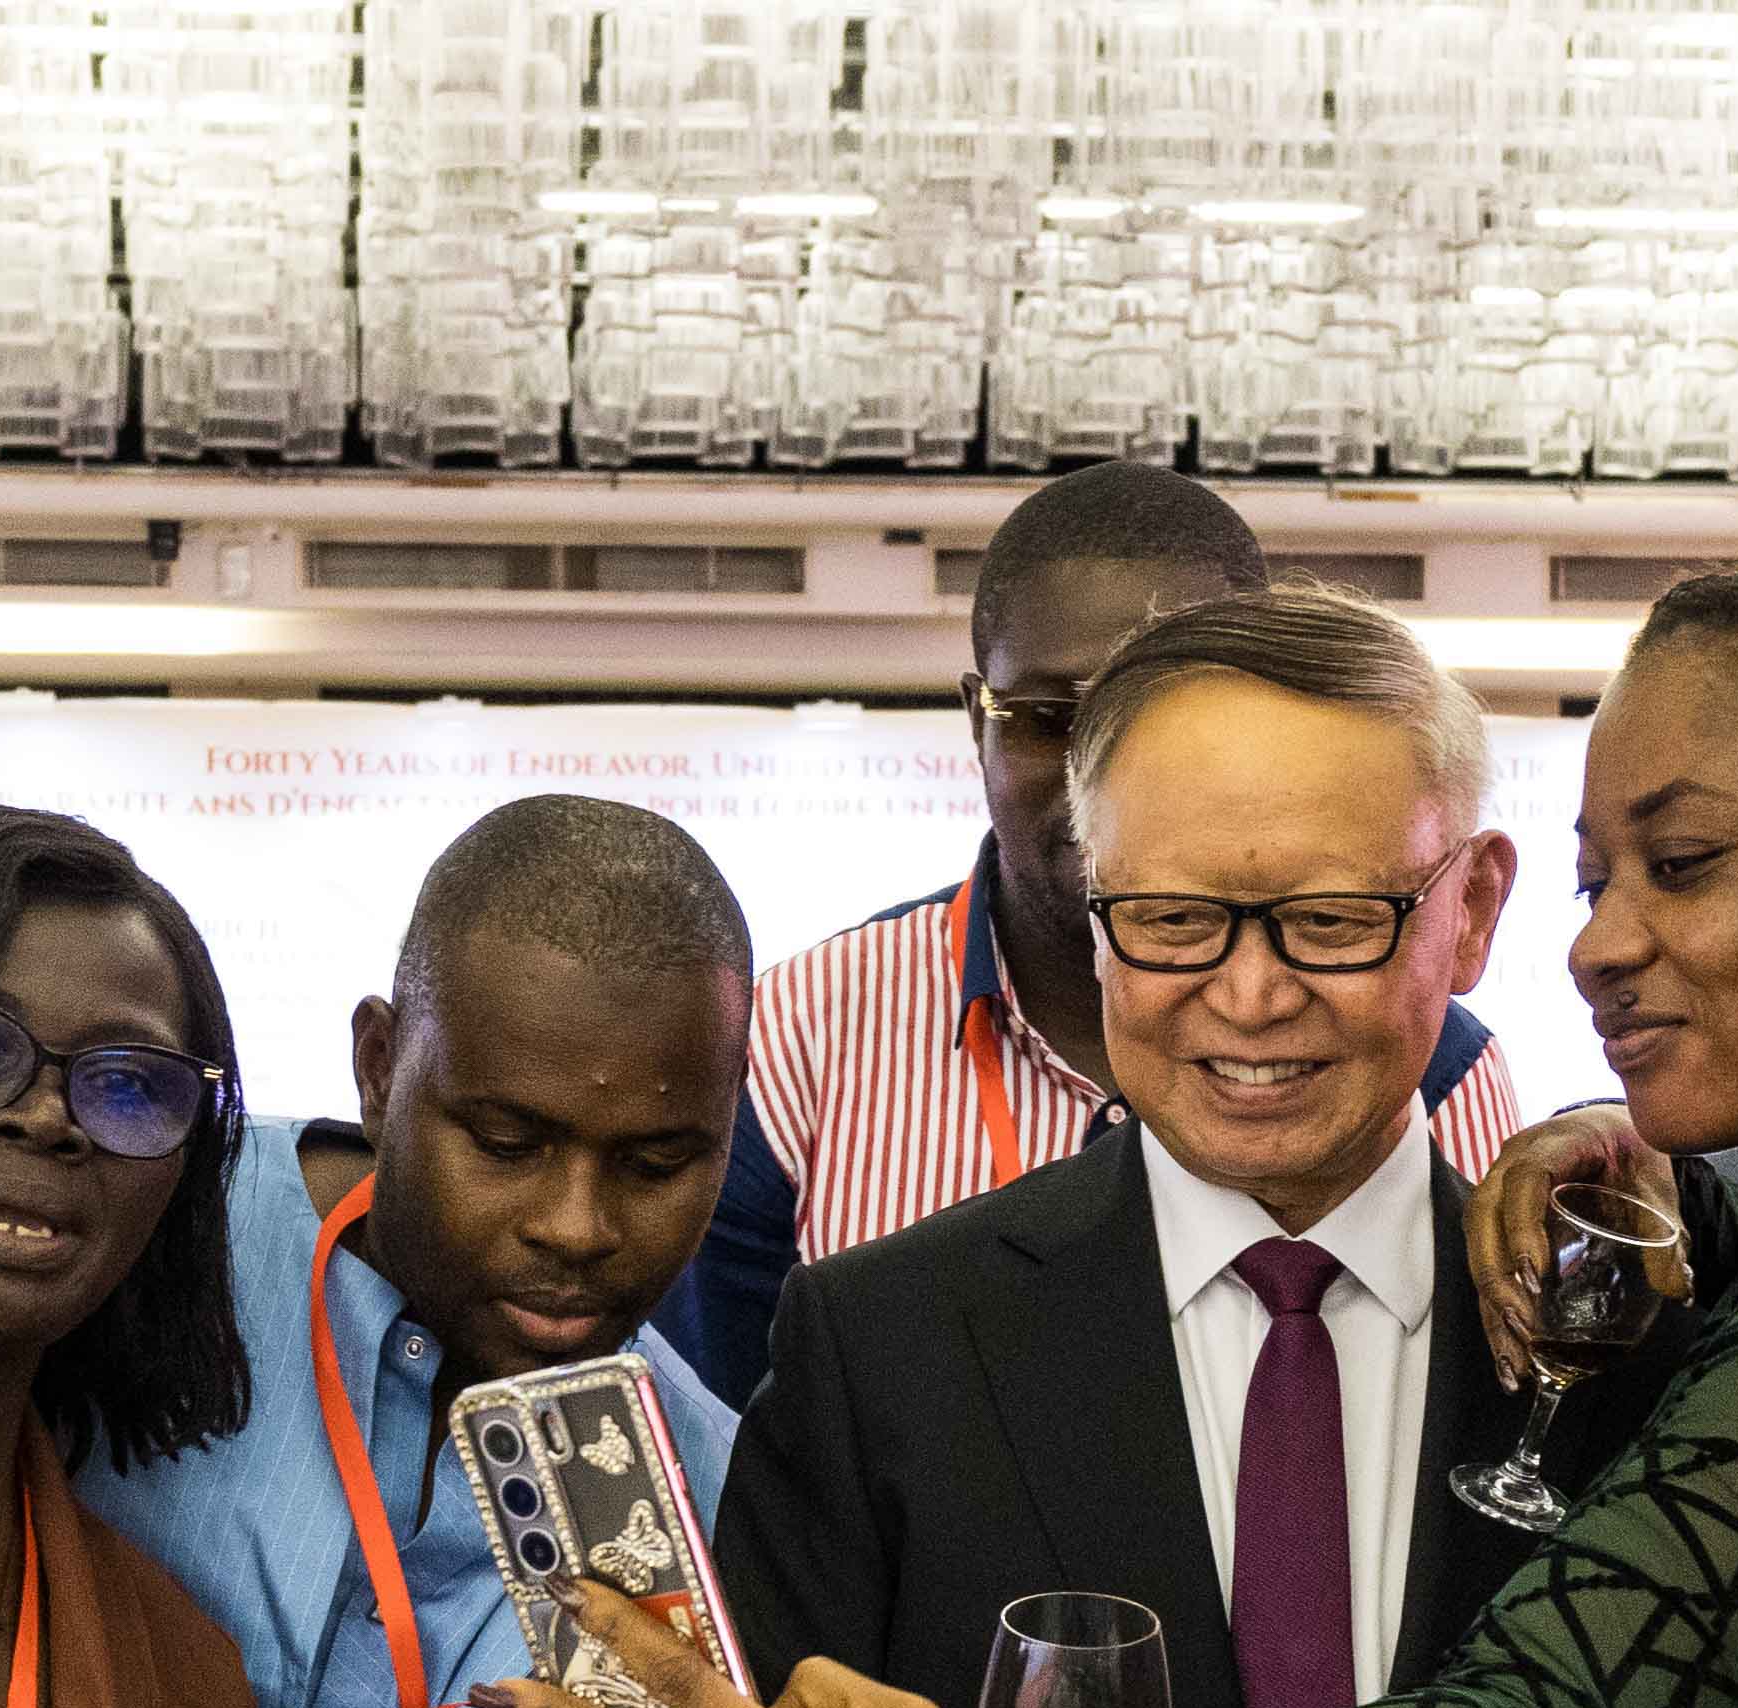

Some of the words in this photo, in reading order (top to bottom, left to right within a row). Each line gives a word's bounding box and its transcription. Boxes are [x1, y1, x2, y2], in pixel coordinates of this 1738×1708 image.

[327, 745, 440, 776] YEARS
[507, 748, 700, 781] ENDEAVOR,
[911, 750, 982, 779] SHA
